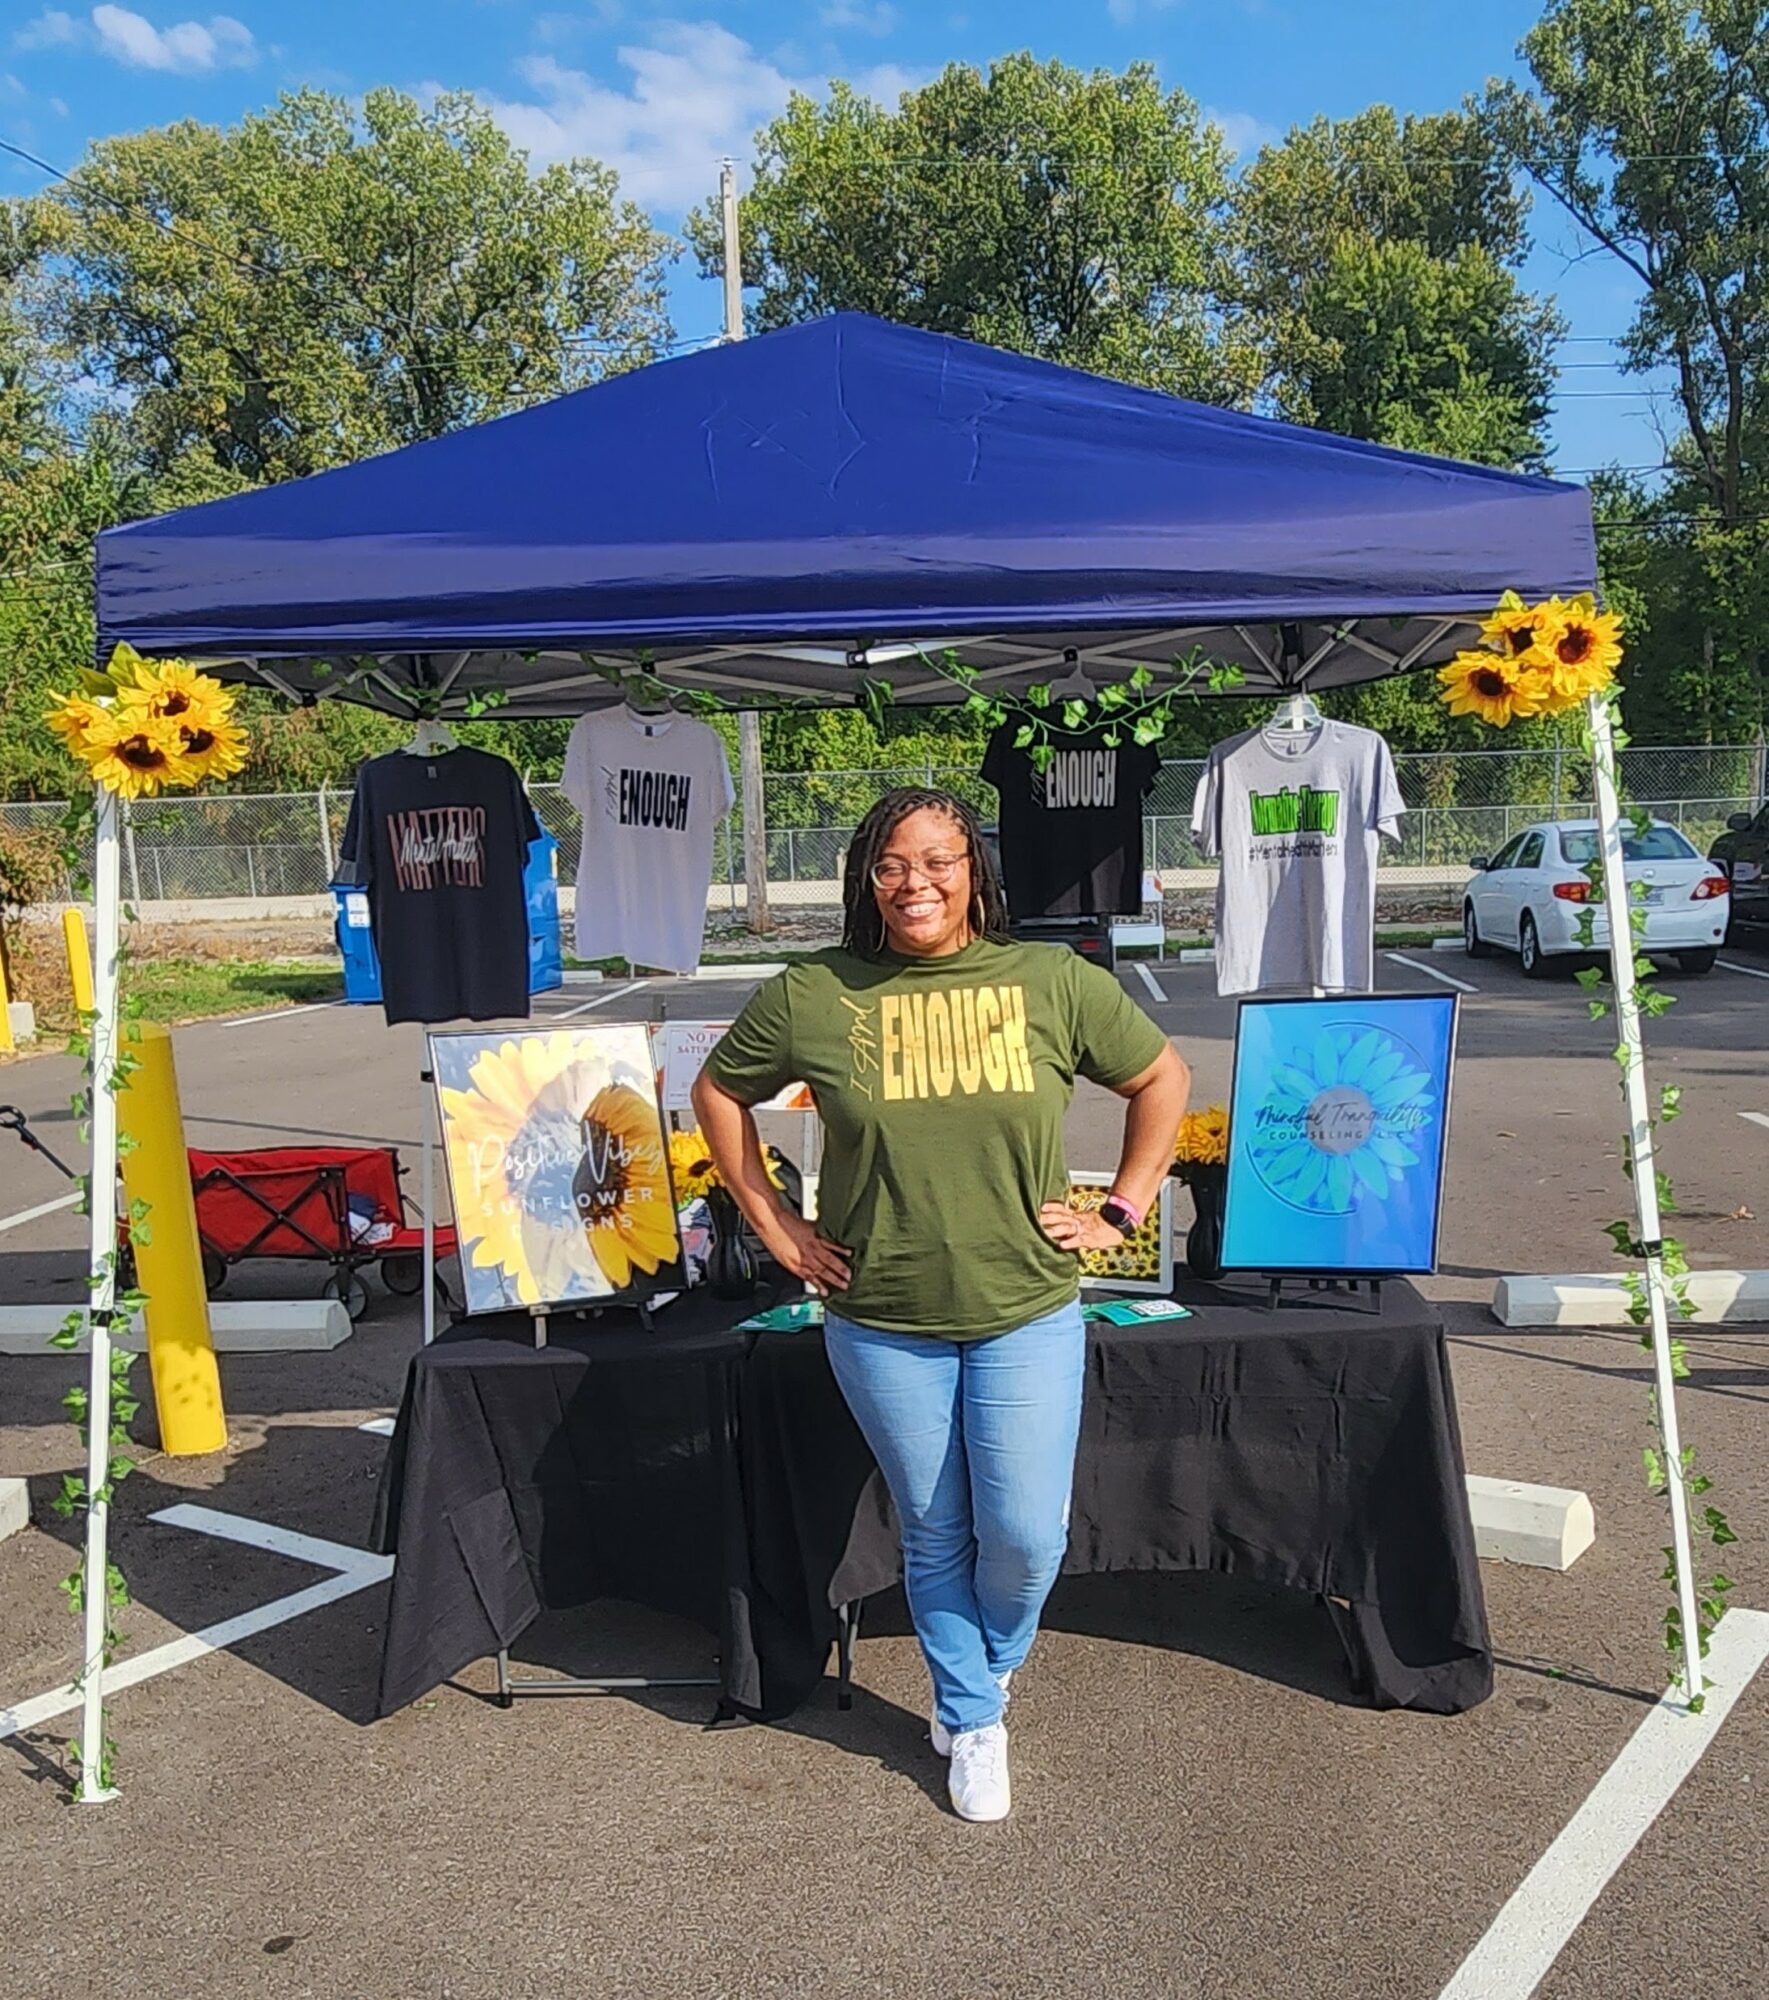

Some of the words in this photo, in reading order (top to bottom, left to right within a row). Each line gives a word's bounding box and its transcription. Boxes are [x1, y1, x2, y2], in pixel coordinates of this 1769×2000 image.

[1046, 750, 1117, 808] ENOUGH
[620, 769, 692, 831] ENOUGH
[387, 806, 486, 892] MATTERS
[400, 826, 443, 868] Mental
[677, 1046, 710, 1054] SATUR
[687, 1032, 706, 1044] NO
[880, 985, 1035, 1101] ENOUGH
[850, 1075, 873, 1102] I
[1255, 1103, 1326, 1130] Mindful
[1269, 1129, 1363, 1141] COUNSELING
[1377, 1130, 1405, 1140] LLC
[467, 1134, 584, 1197] Positive
[481, 1186, 655, 1217] SUNFLOWER
